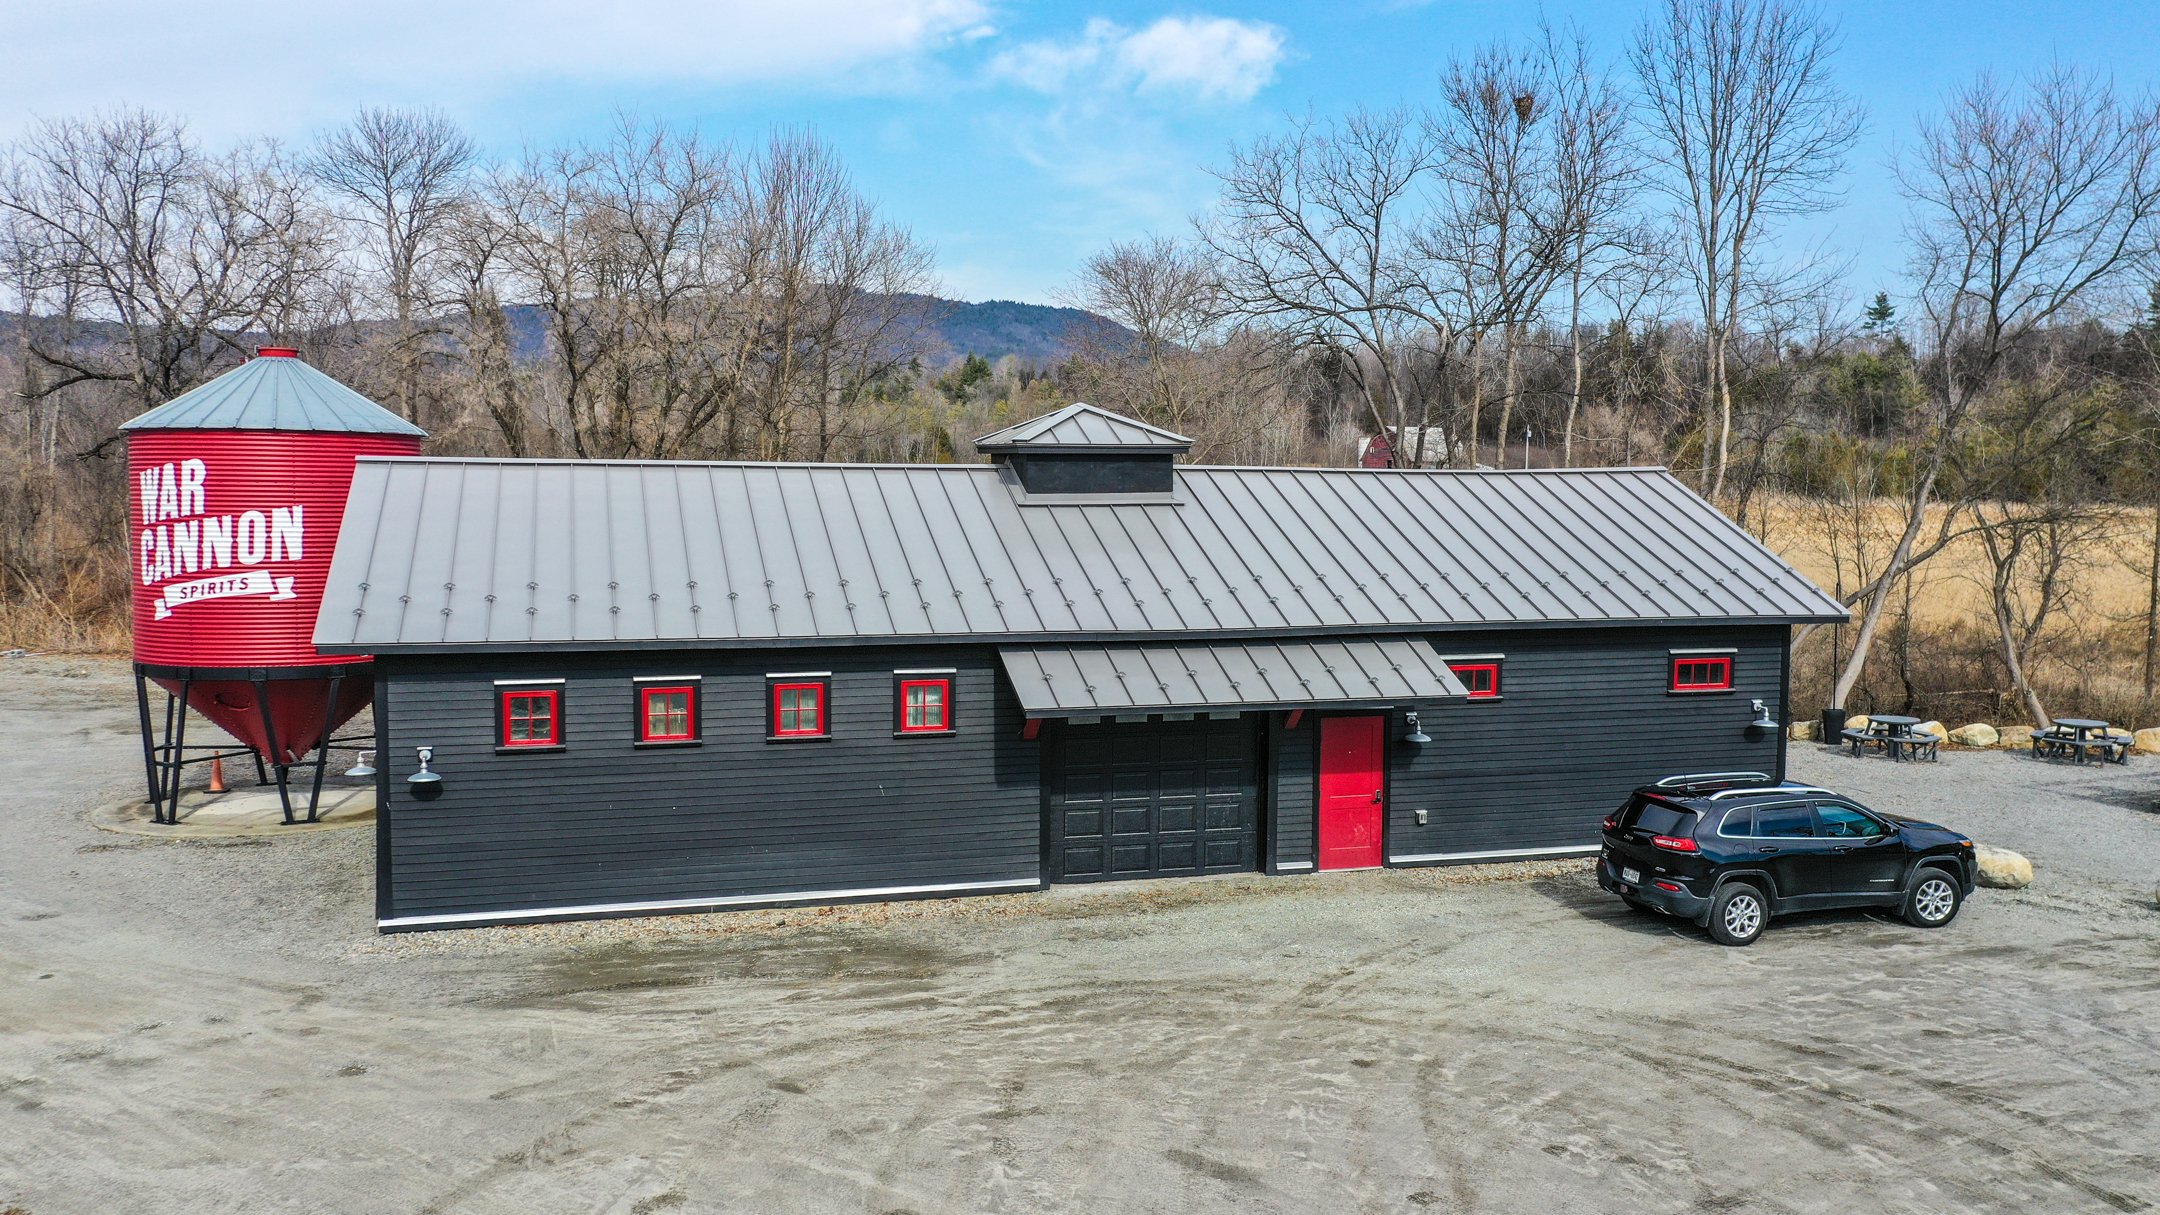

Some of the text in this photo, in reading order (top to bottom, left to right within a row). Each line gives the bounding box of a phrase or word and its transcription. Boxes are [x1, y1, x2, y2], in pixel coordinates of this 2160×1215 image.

[139, 458, 207, 525] WAR
[140, 504, 304, 586] CANNON
[179, 577, 249, 600] SPIRITS
